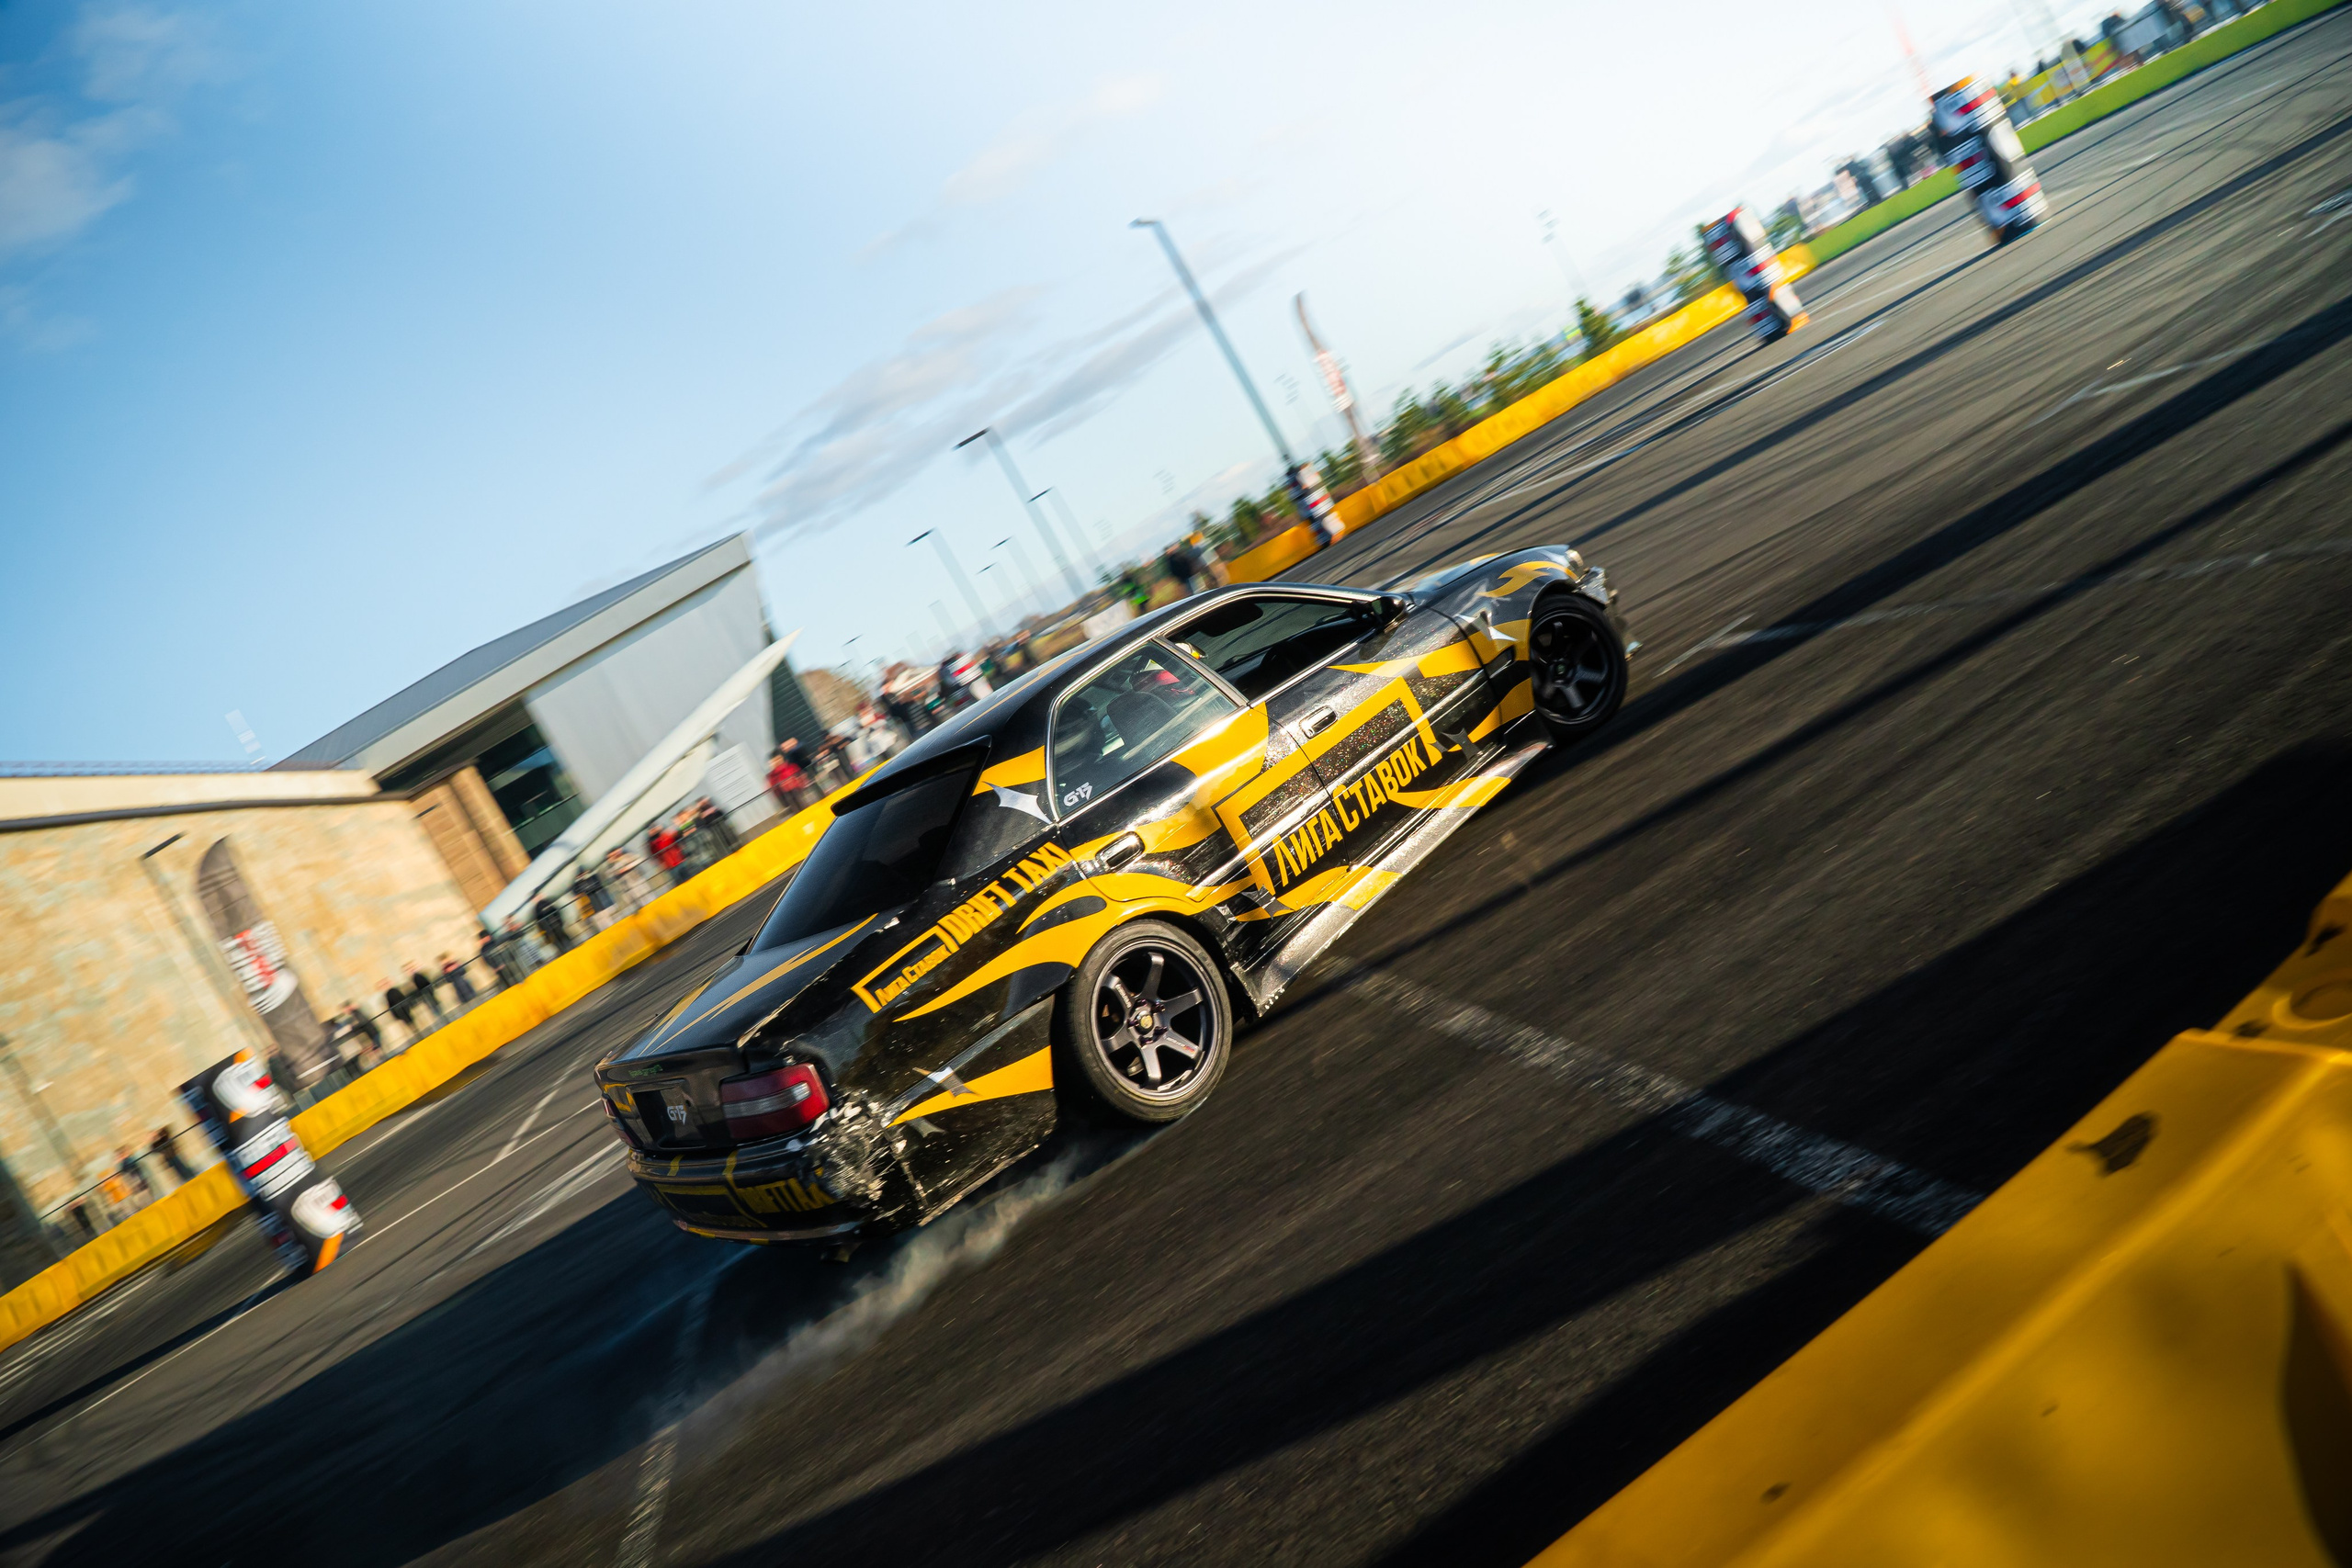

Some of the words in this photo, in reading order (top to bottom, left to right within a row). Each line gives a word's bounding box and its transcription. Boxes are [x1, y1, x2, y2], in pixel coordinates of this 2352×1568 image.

[1272, 807, 1343, 887] ЛИГА
[1332, 737, 1428, 832] СТАВОК
[936, 880, 1018, 945] DRIFT
[1001, 841, 1073, 894] TAXI
